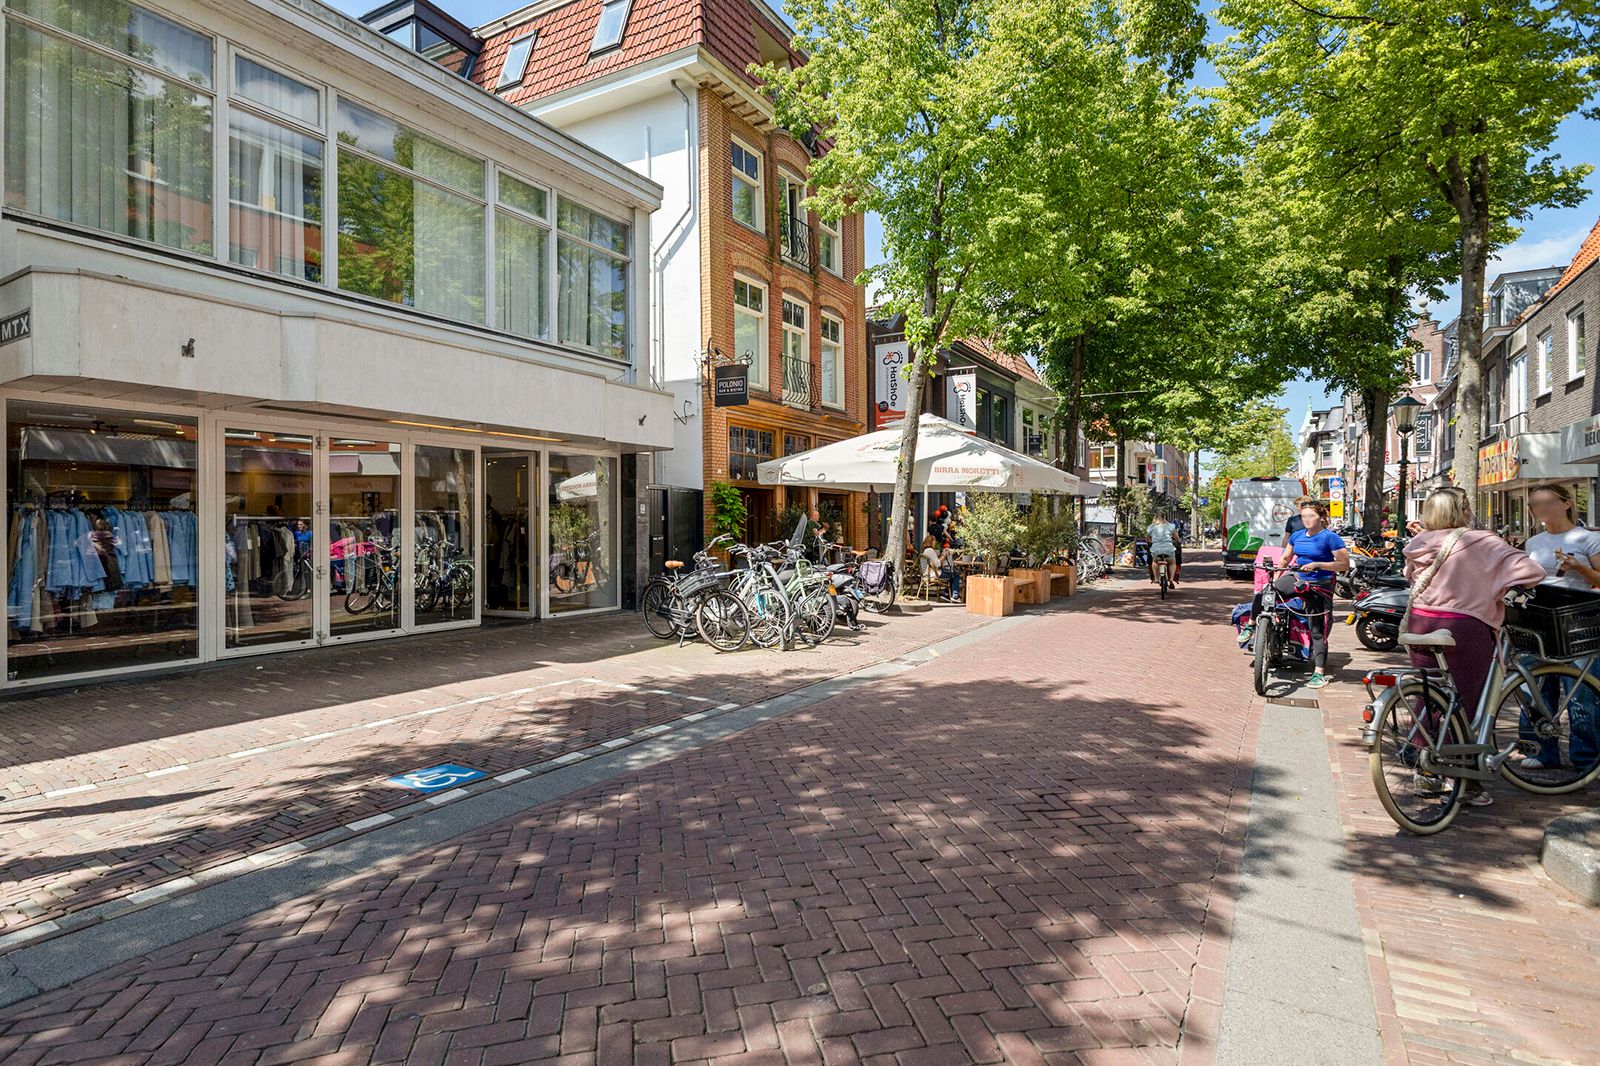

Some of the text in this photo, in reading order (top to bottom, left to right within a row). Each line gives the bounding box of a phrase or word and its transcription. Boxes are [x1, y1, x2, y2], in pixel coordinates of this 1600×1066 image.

[2, 315, 29, 340] MTX
[719, 380, 743, 388] POLONIO
[934, 466, 1000, 475] BIRRA MORETTI
